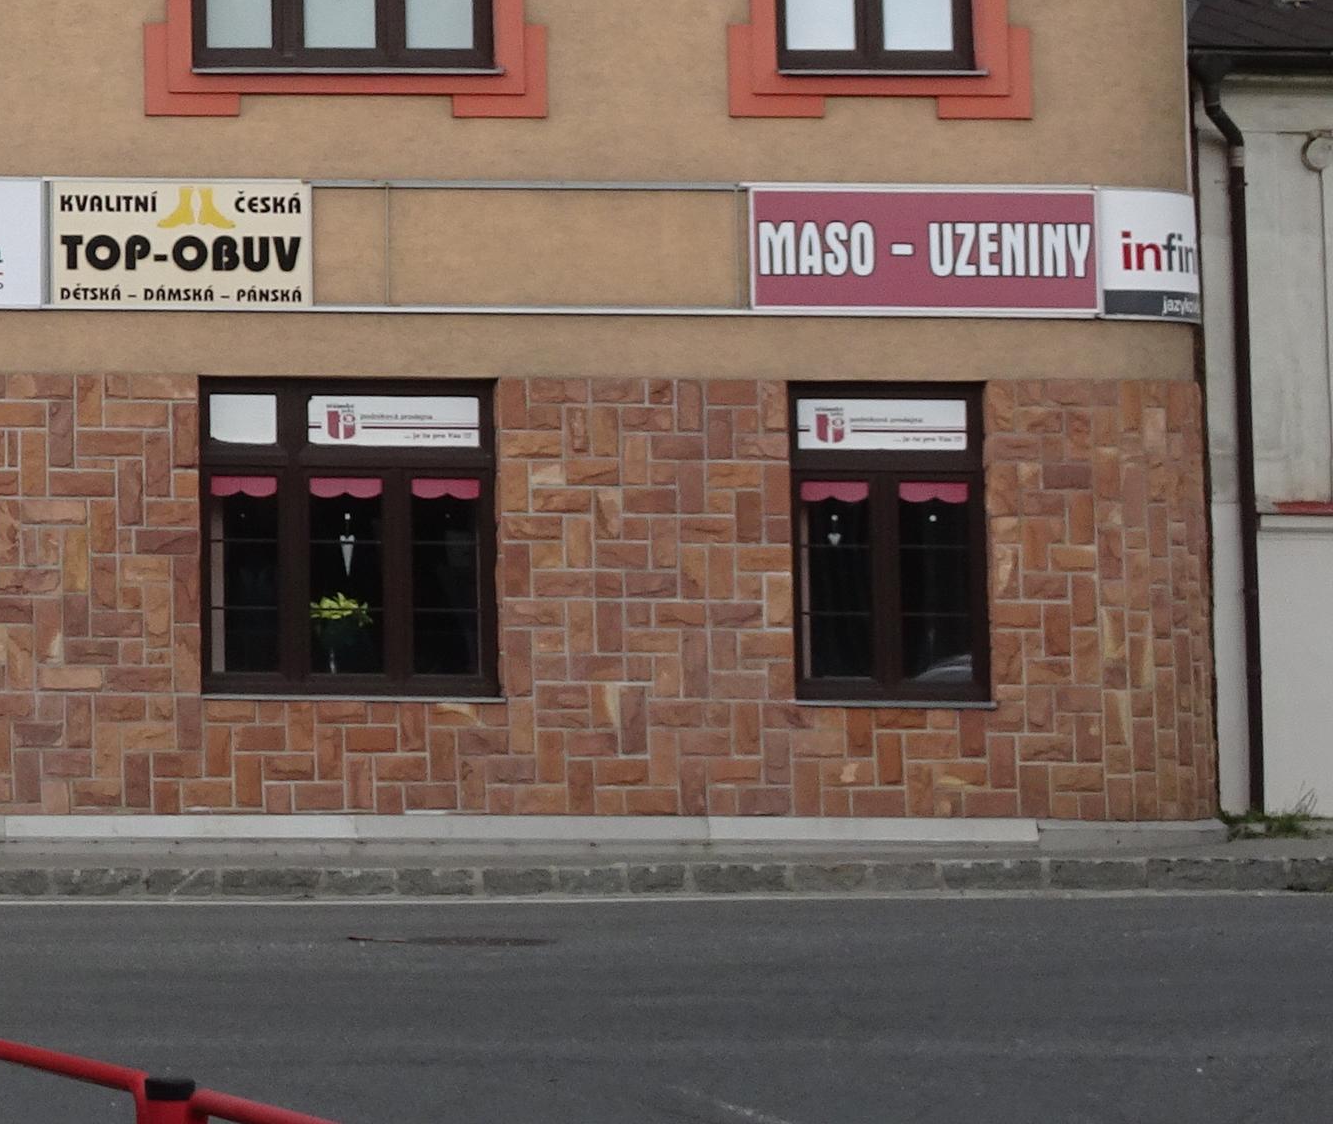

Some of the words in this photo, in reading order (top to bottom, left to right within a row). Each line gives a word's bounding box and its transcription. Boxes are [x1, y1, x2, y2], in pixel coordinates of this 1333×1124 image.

[60, 191, 158, 213] KVALITNÍ
[234, 190, 301, 214] ČESKÁ
[60, 234, 301, 272] TOP-OBUV
[758, 221, 875, 276] MASO
[928, 222, 1092, 278] UZENINY
[60, 283, 121, 301] DĚTSKÁ
[143, 285, 214, 301] DÁMSKÁ
[236, 286, 302, 302] PÁNSKÁ
